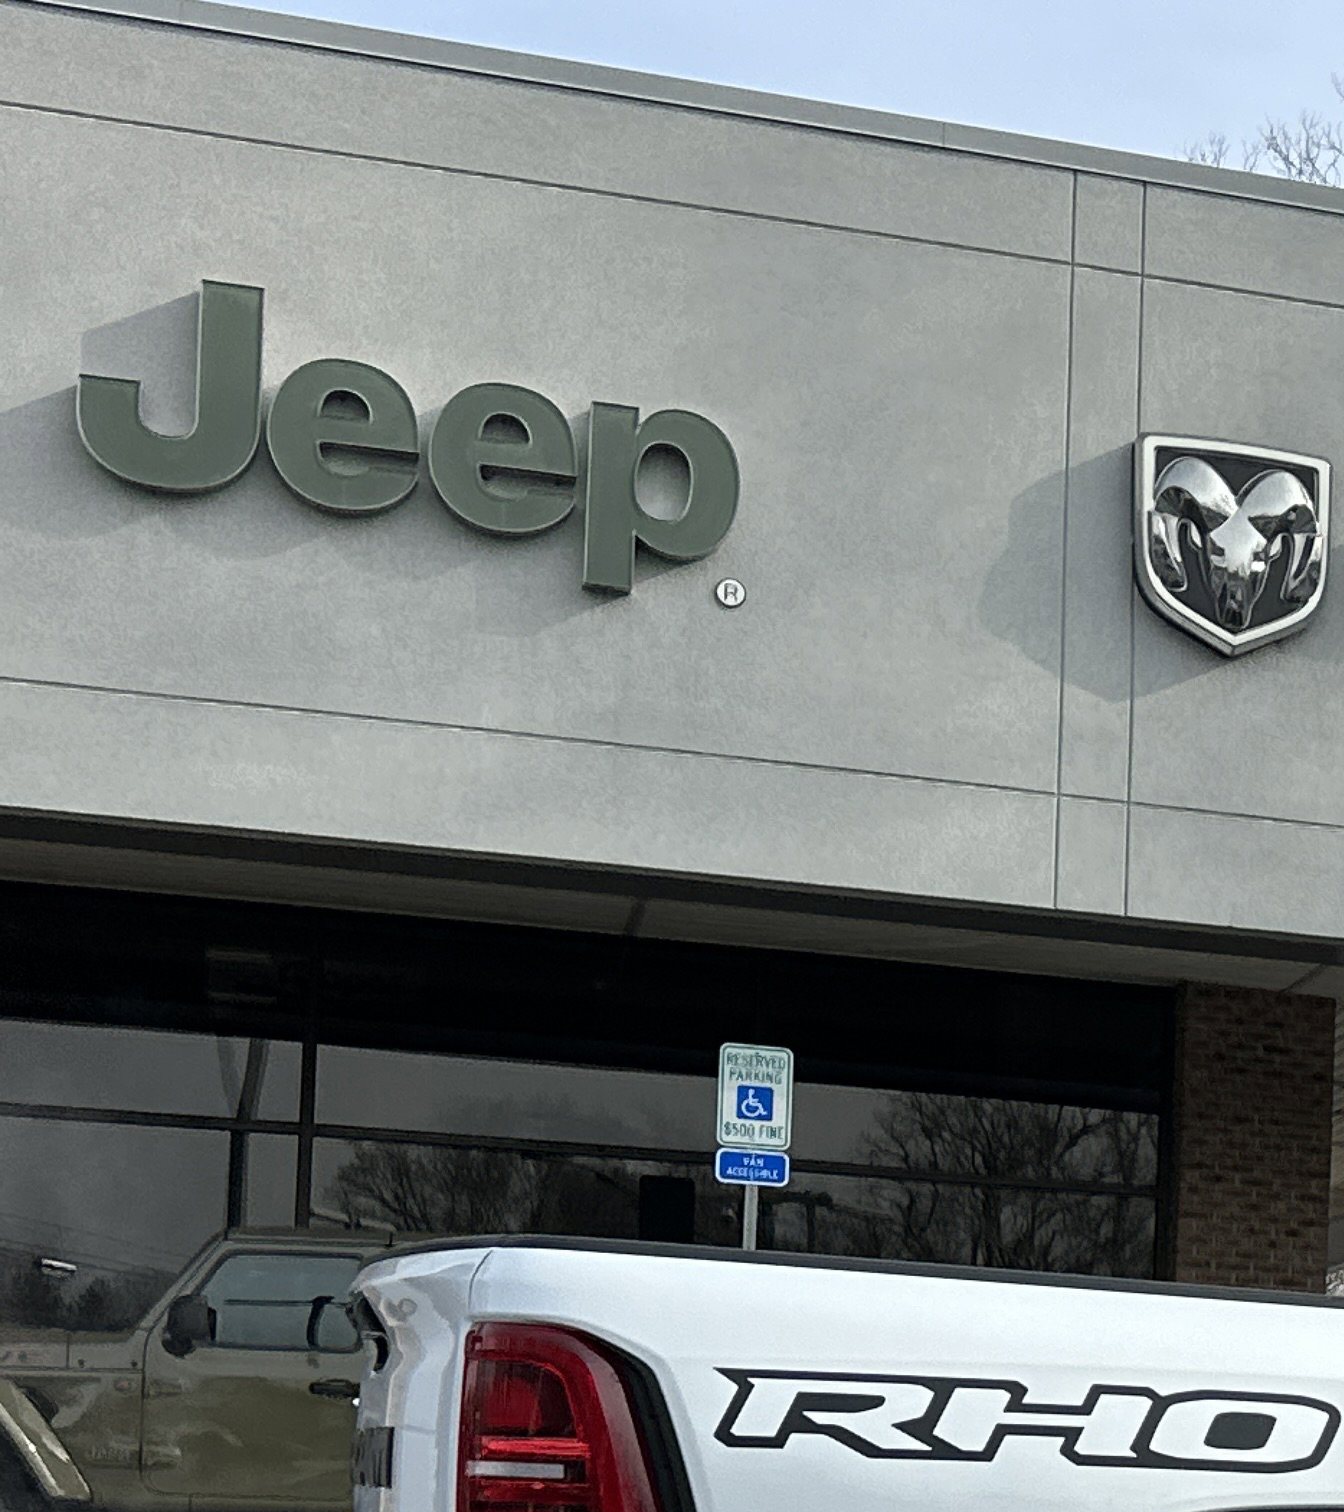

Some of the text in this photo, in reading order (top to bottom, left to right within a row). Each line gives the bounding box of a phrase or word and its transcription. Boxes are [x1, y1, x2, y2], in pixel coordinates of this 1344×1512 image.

[77, 279, 740, 594] Jeep
[727, 1052, 786, 1071] RESERVED
[729, 1067, 782, 1085] PARKING
[724, 1121, 785, 1140] $500 FINE
[712, 1367, 1341, 1473] RHO
